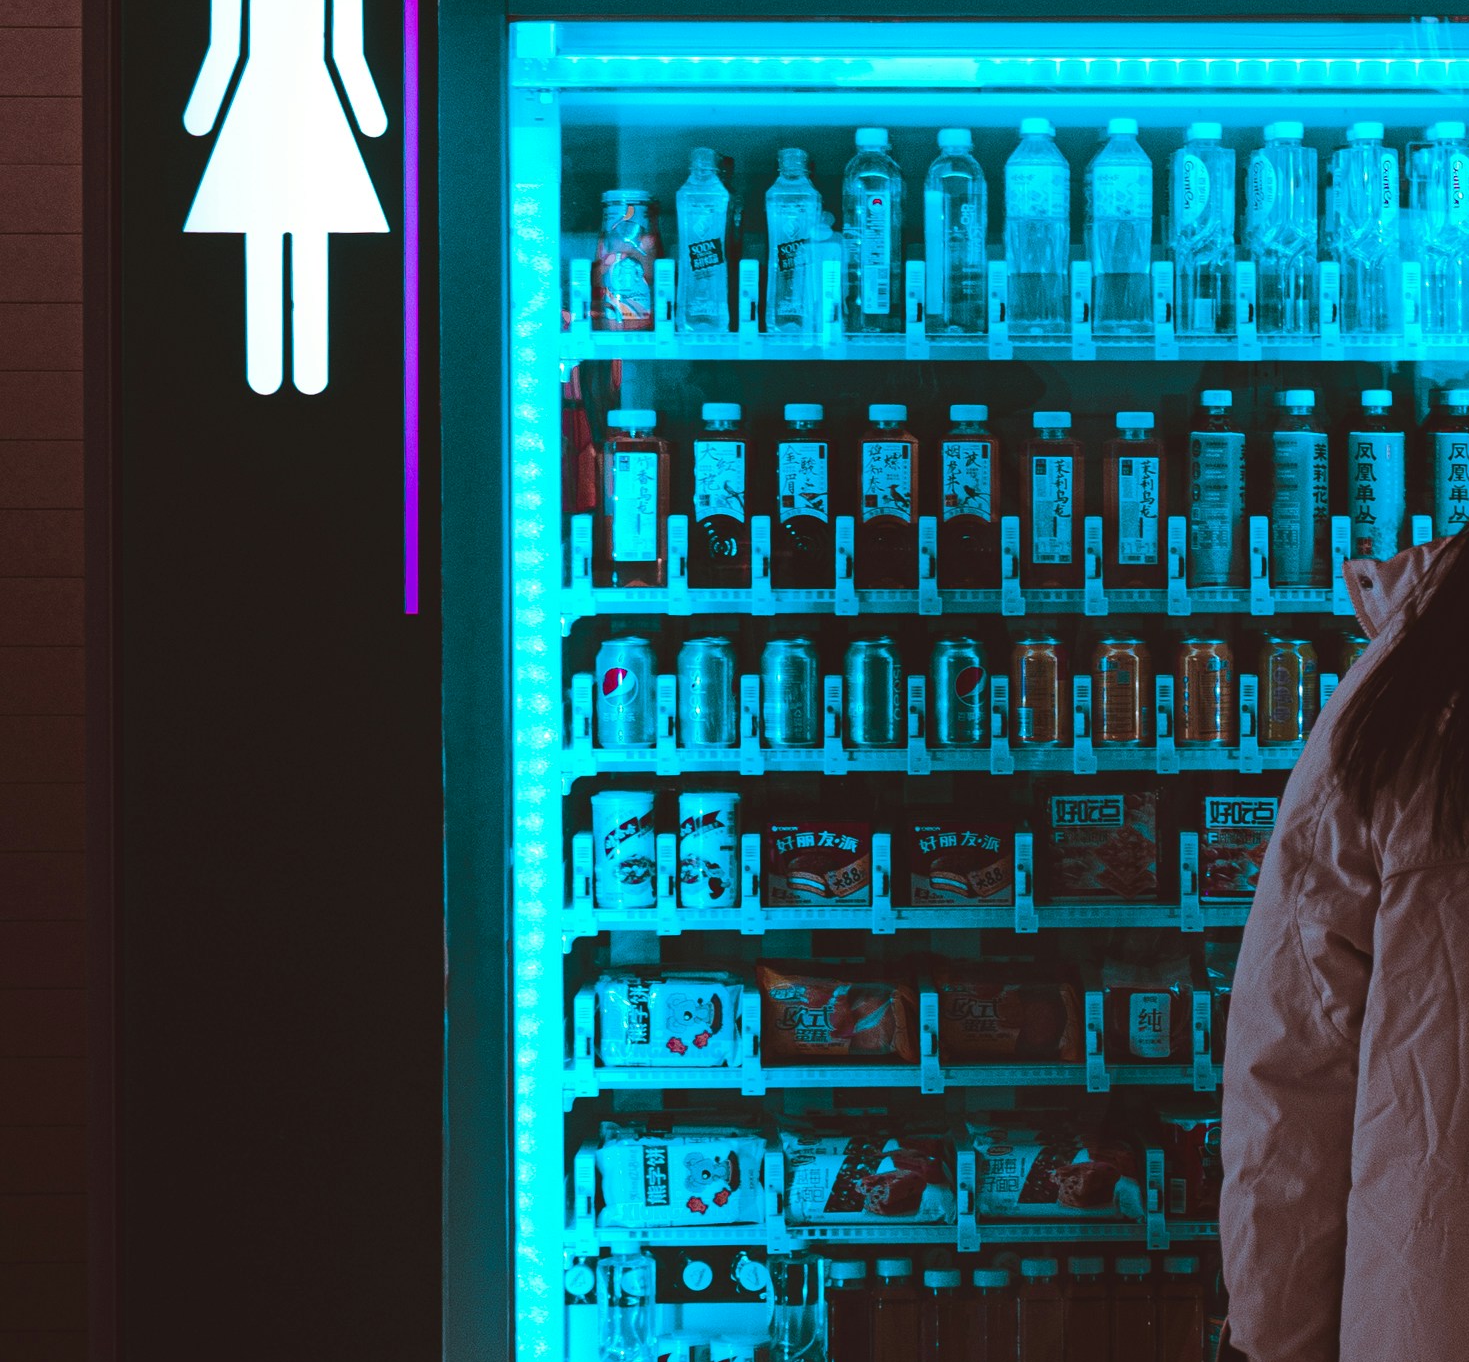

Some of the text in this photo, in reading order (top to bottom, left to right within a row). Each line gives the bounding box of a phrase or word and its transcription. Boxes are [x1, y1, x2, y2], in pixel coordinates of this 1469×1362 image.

[691, 241, 717, 255] SODA
[1312, 442, 1327, 526] 茉莉花茶
[1354, 441, 1377, 525] 凤凰单丛
[1056, 799, 1120, 824] 好吃点
[1210, 801, 1274, 825] 好吃点
[776, 1005, 835, 1030] 欧式
[1138, 1008, 1162, 1032] 纯
